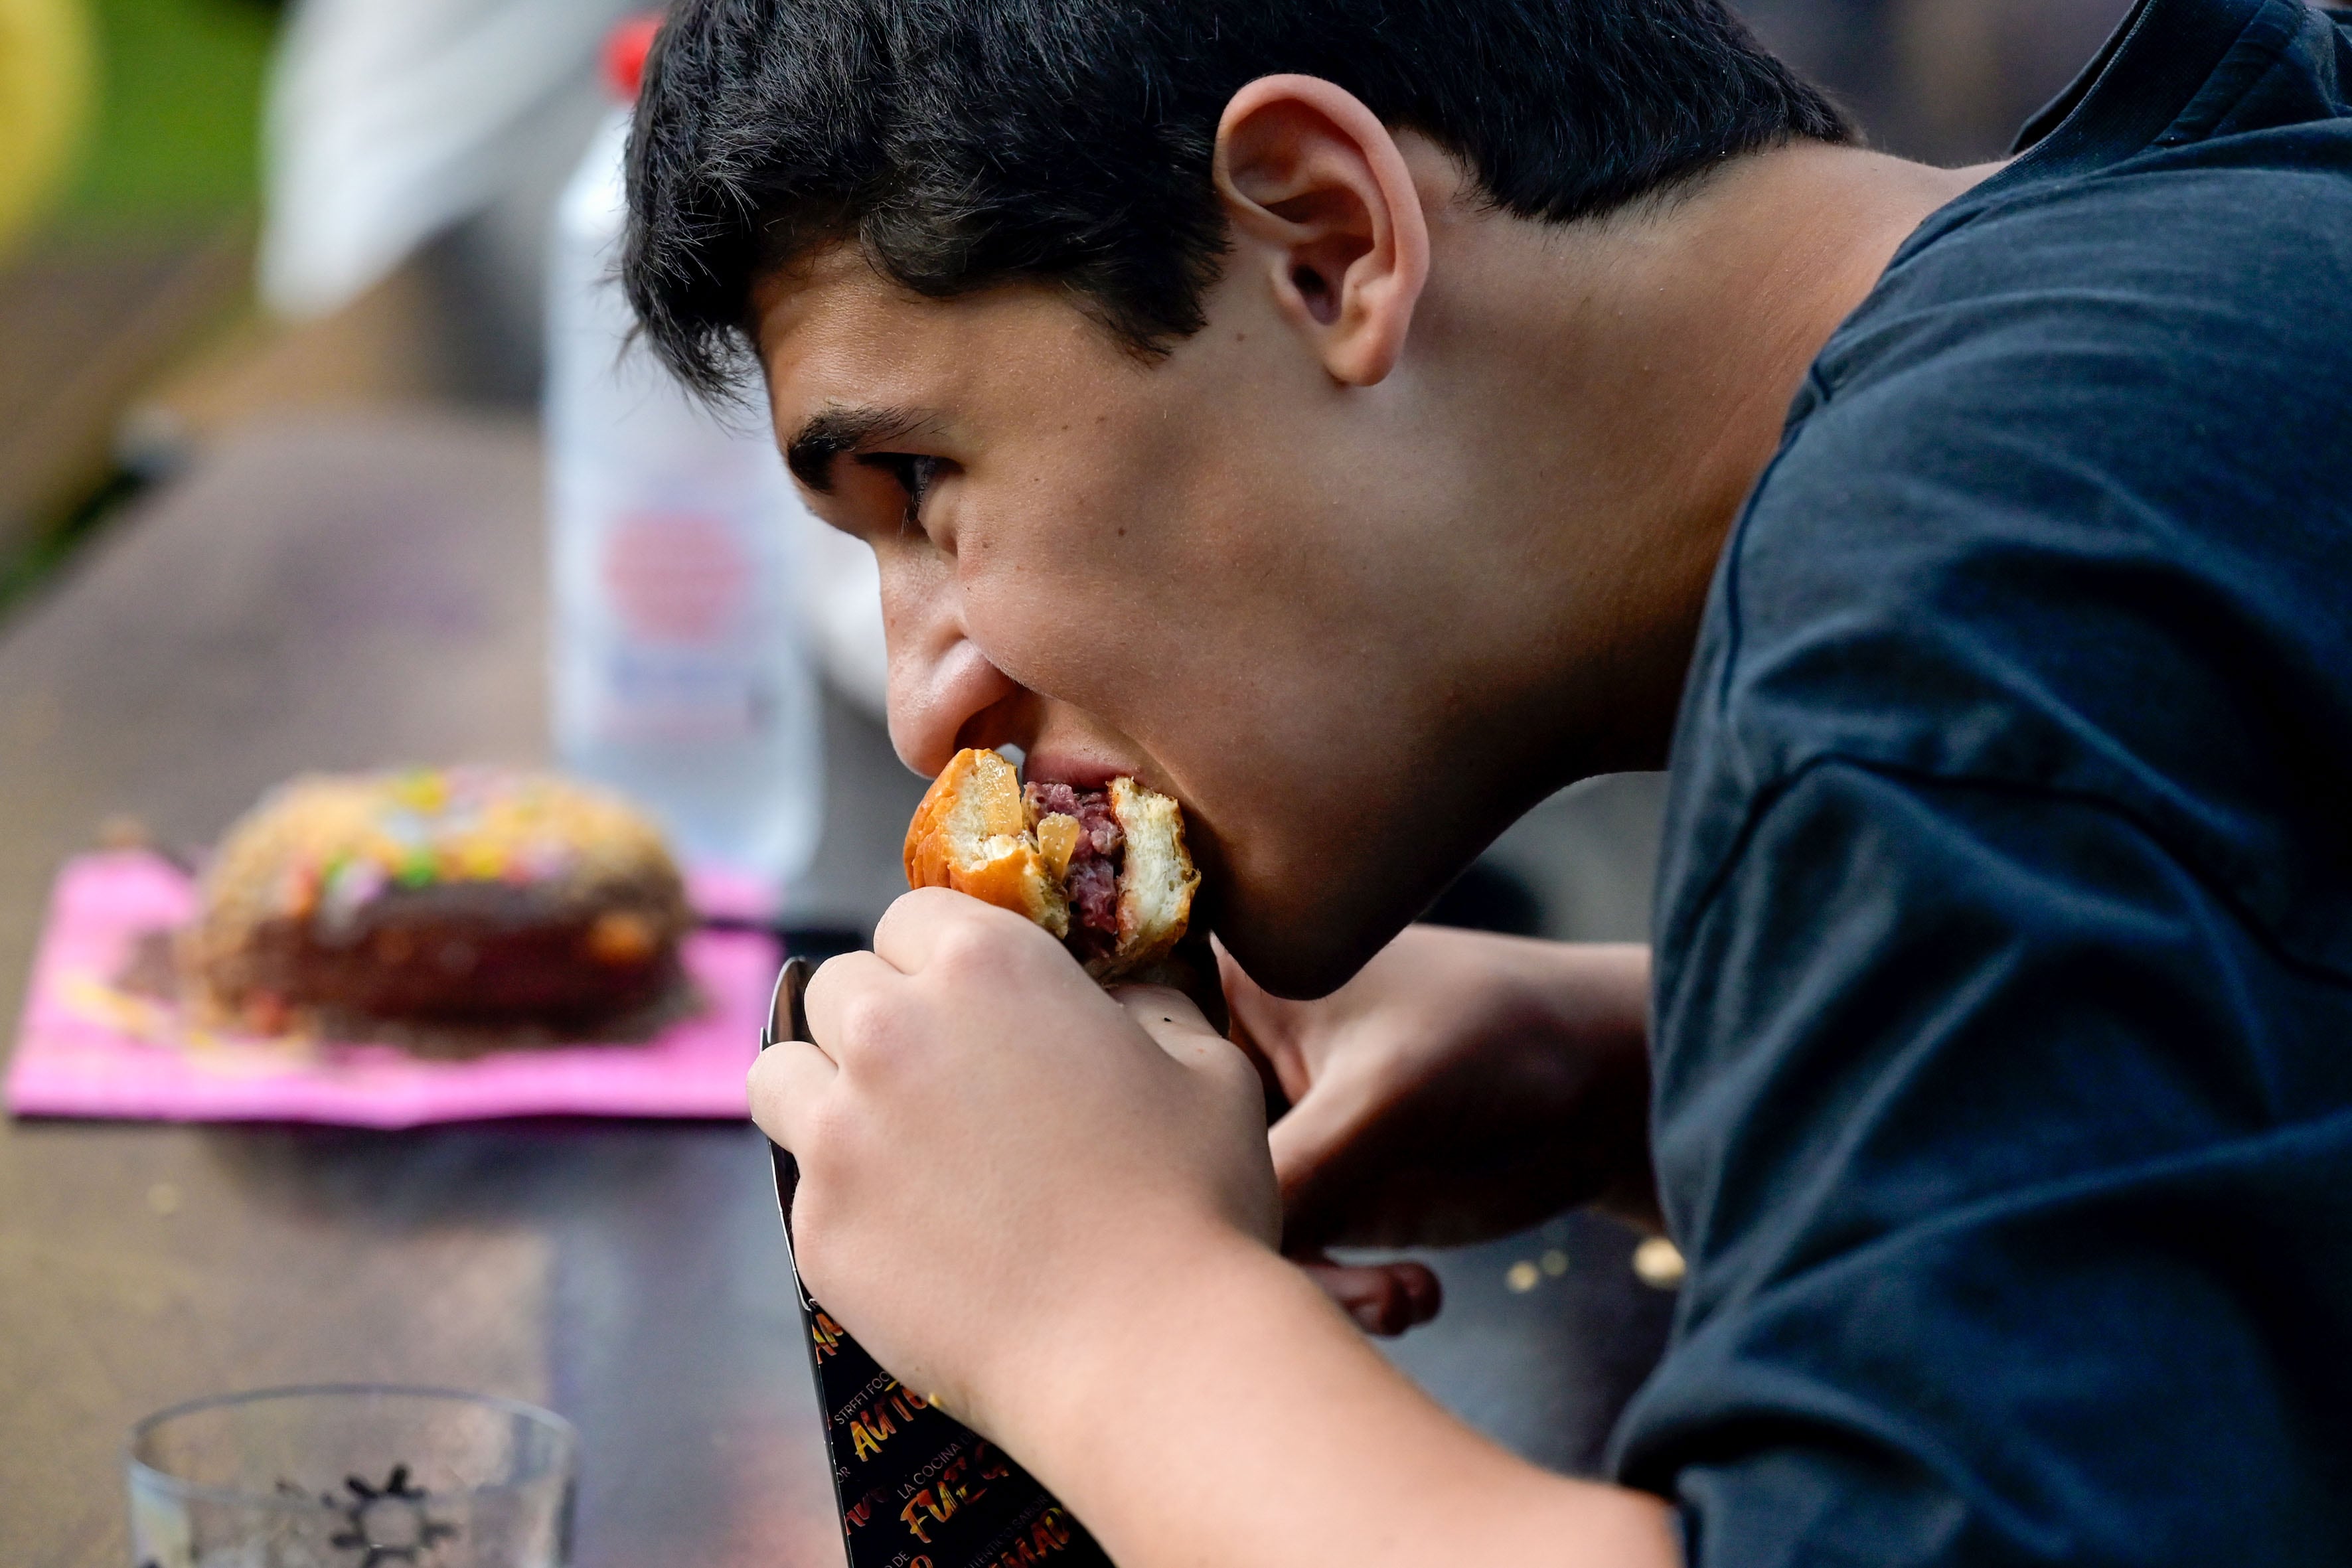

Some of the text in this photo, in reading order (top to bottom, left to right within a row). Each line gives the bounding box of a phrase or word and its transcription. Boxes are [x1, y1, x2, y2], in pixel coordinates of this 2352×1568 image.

[866, 1371, 891, 1395] FOO
[898, 1483, 917, 1499] LA
[913, 1443, 963, 1485] COCINA
[900, 1441, 1010, 1544] FUEG
